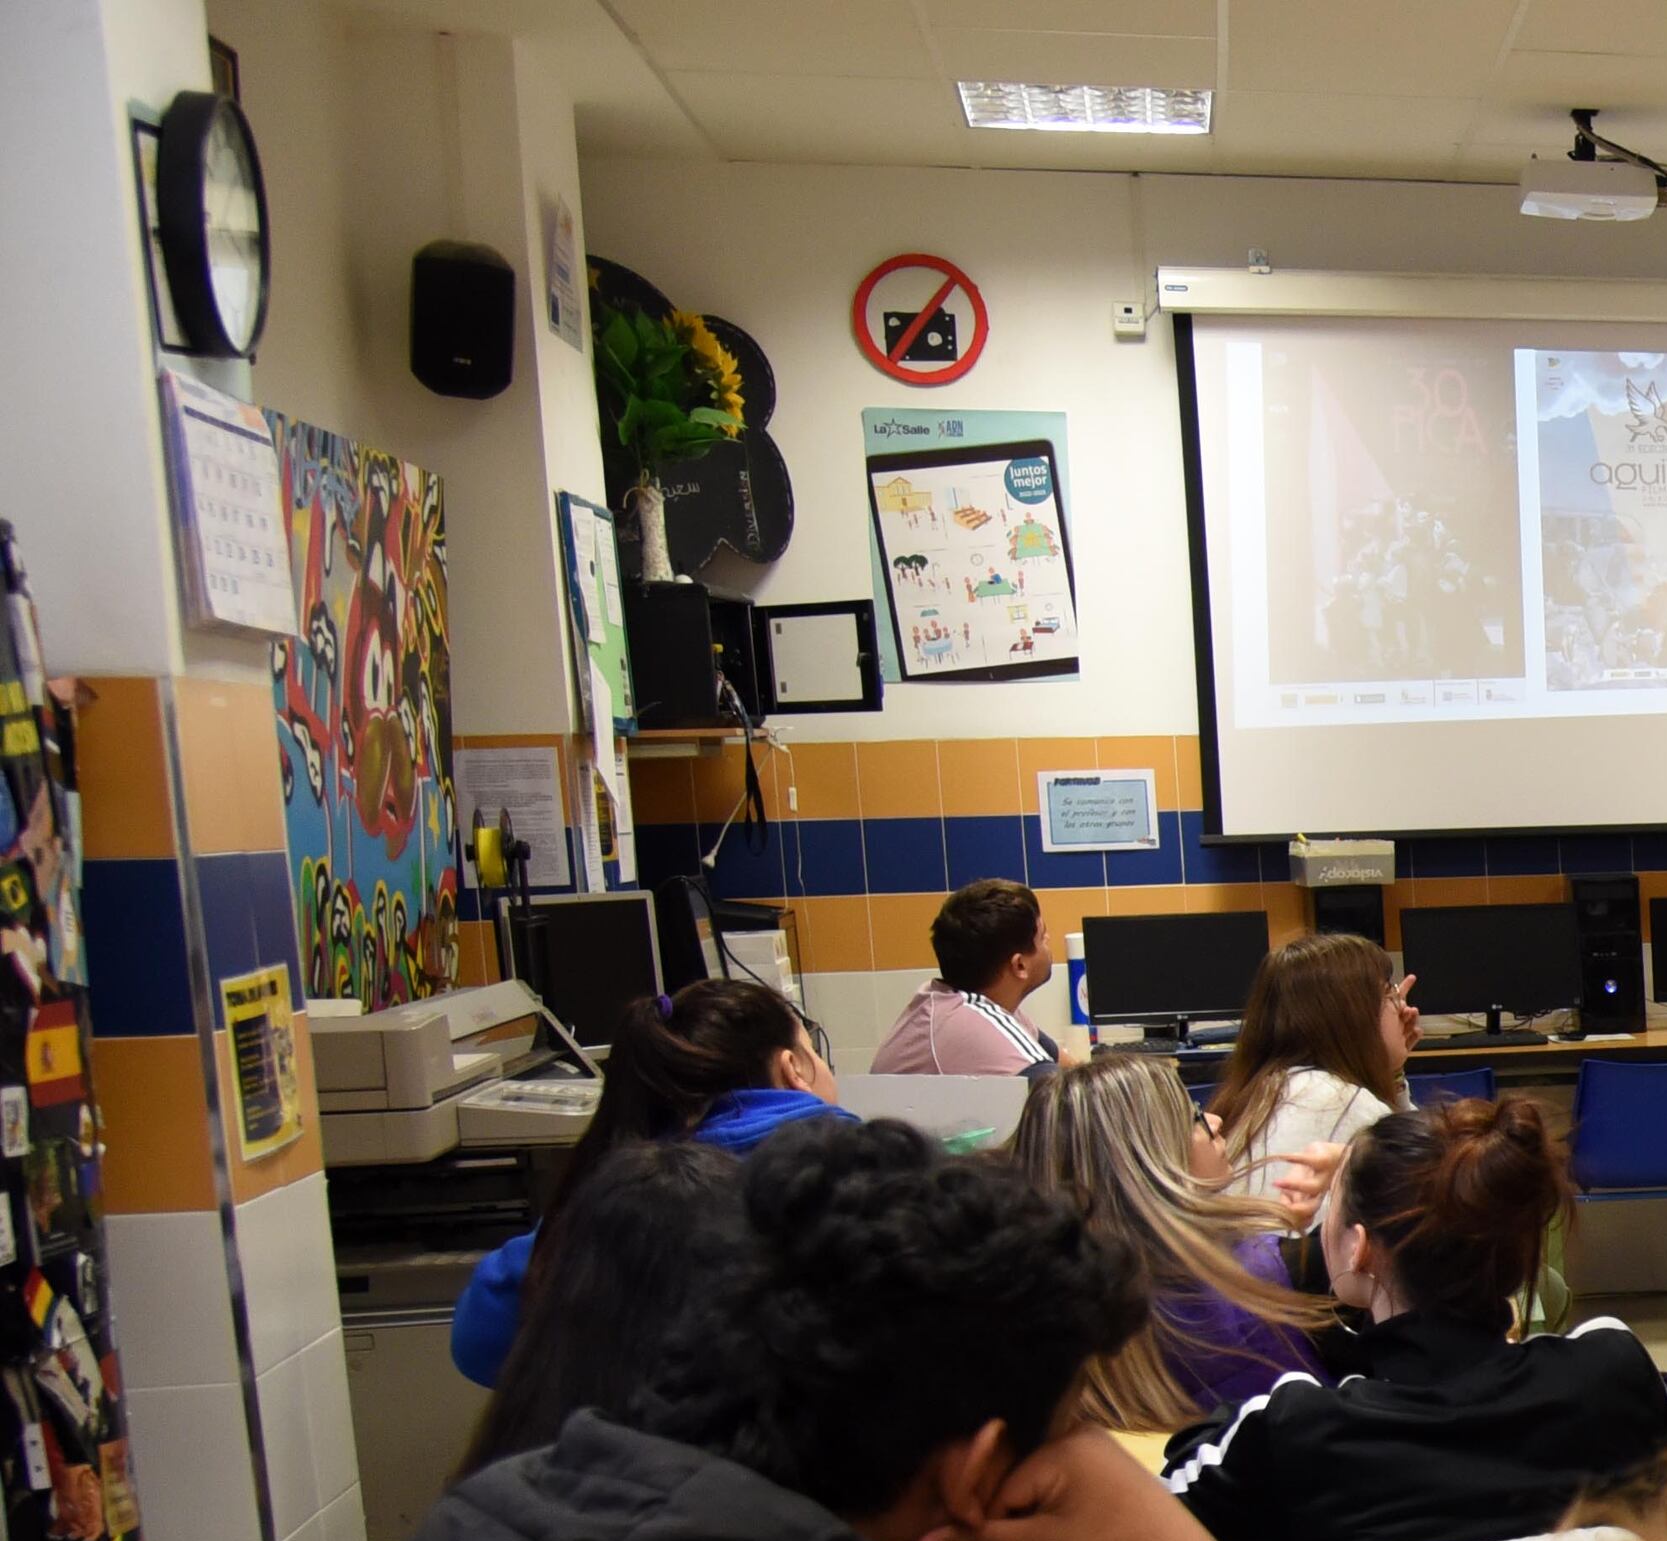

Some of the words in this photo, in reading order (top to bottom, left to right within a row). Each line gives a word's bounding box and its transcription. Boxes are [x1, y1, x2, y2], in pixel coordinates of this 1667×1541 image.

[874, 425, 886, 434] La
[902, 424, 930, 435] Salle
[1009, 465, 1047, 479] Juntos
[1013, 475, 1047, 490] mejor
